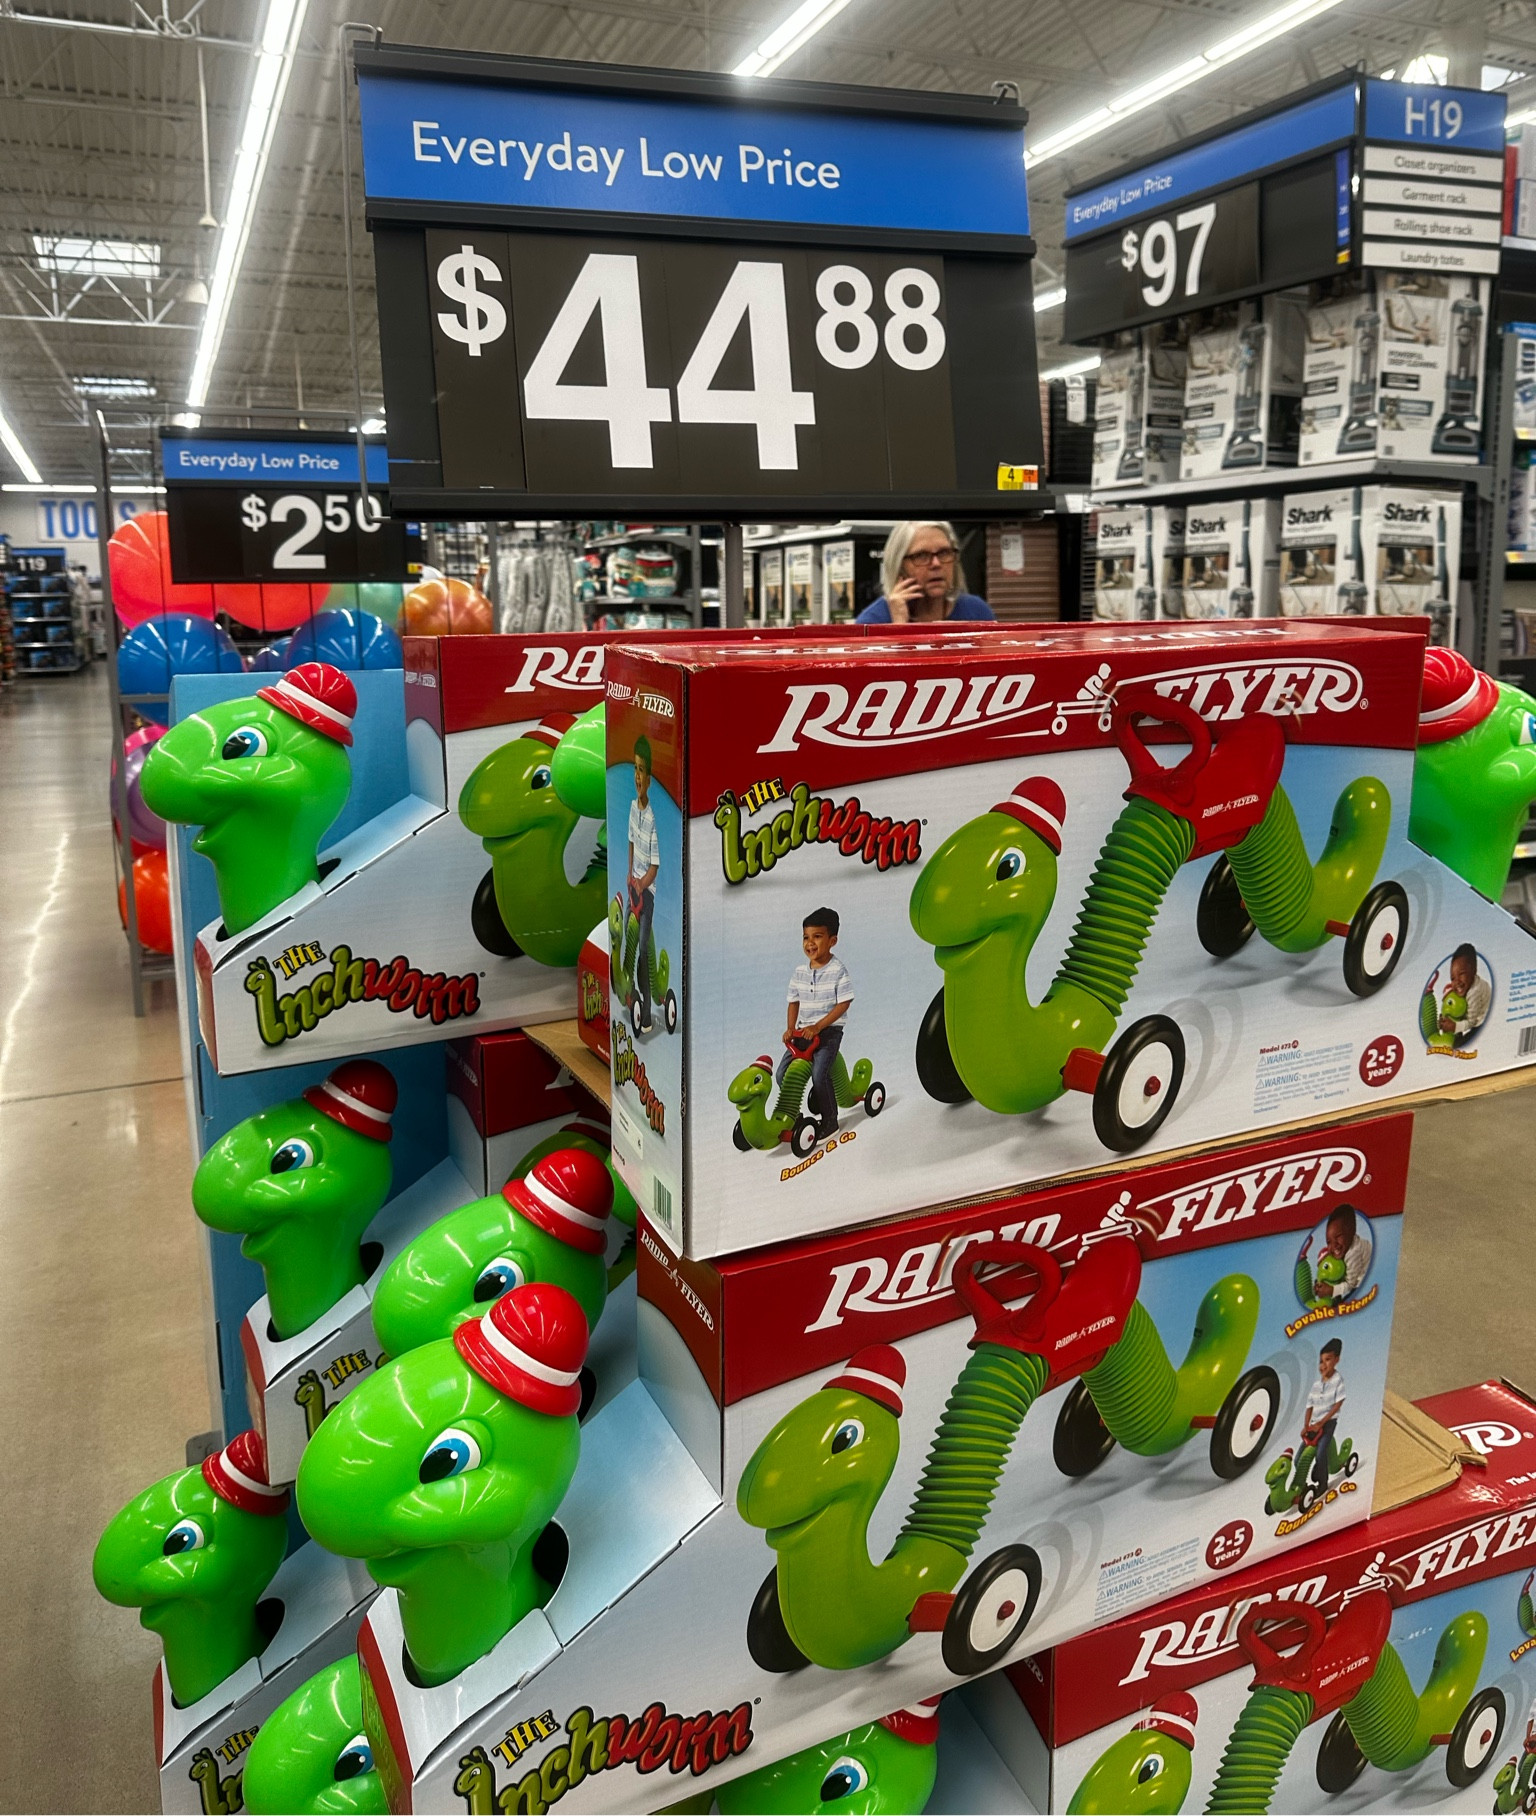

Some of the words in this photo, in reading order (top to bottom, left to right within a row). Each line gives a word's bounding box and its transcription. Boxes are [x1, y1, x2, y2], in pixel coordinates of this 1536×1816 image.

[1405, 96, 1463, 139] H19
[413, 121, 624, 186] Everyday
[640, 137, 723, 181] Low
[739, 145, 840, 188] Price
[1394, 156, 1426, 168] Closet
[1428, 160, 1476, 174] organizers
[1073, 197, 1120, 223] Everyday
[1120, 187, 1142, 205] Low
[1143, 175, 1173, 196] Price
[1402, 188, 1445, 203] Garment
[1447, 193, 1467, 204] rack
[1394, 218, 1428, 235] Rolling
[1430, 221, 1451, 233] shoe
[1453, 224, 1474, 236] rack
[1401, 251, 1438, 266] Laundry
[180, 451, 257, 472] Everyday
[262, 454, 294, 468] Low
[299, 453, 340, 470] Price
[1007, 468, 1015, 482] 4
[40, 500, 137, 539] TOOS
[1101, 521, 1132, 539] Shark
[1189, 517, 1226, 534] Shark
[1287, 505, 1334, 525] Shark
[1384, 503, 1432, 523] Shark
[607, 681, 632, 700] RADIO
[640, 693, 675, 718] FLYER
[757, 674, 1052, 753] RADIO
[740, 776, 787, 816] THE
[713, 781, 922, 886] Inchworm
[273, 941, 327, 980] THE
[243, 944, 482, 1047] Inchworm
[1366, 1044, 1397, 1069] 2-5
[1367, 1065, 1393, 1081] years
[611, 1018, 666, 1138] Inchworm
[780, 1149, 824, 1181] Bounce
[826, 1139, 838, 1153] &
[840, 1131, 857, 1144] Go
[1136, 1147, 1367, 1241] FLYER
[641, 1228, 670, 1269] RADIO
[678, 1275, 715, 1332] FLYER
[1284, 1305, 1336, 1338] Lovable
[1337, 1283, 1378, 1317] Friend
[321, 1348, 372, 1390] THE
[1274, 1501, 1324, 1537] Bounce
[1325, 1489, 1338, 1504] &
[1339, 1481, 1357, 1494] Go
[1213, 1526, 1246, 1556] 2-5
[1214, 1547, 1241, 1566] years
[1390, 1503, 1536, 1590] FLYE
[453, 1701, 754, 1815] Inchworm
[491, 1709, 561, 1769] THE
